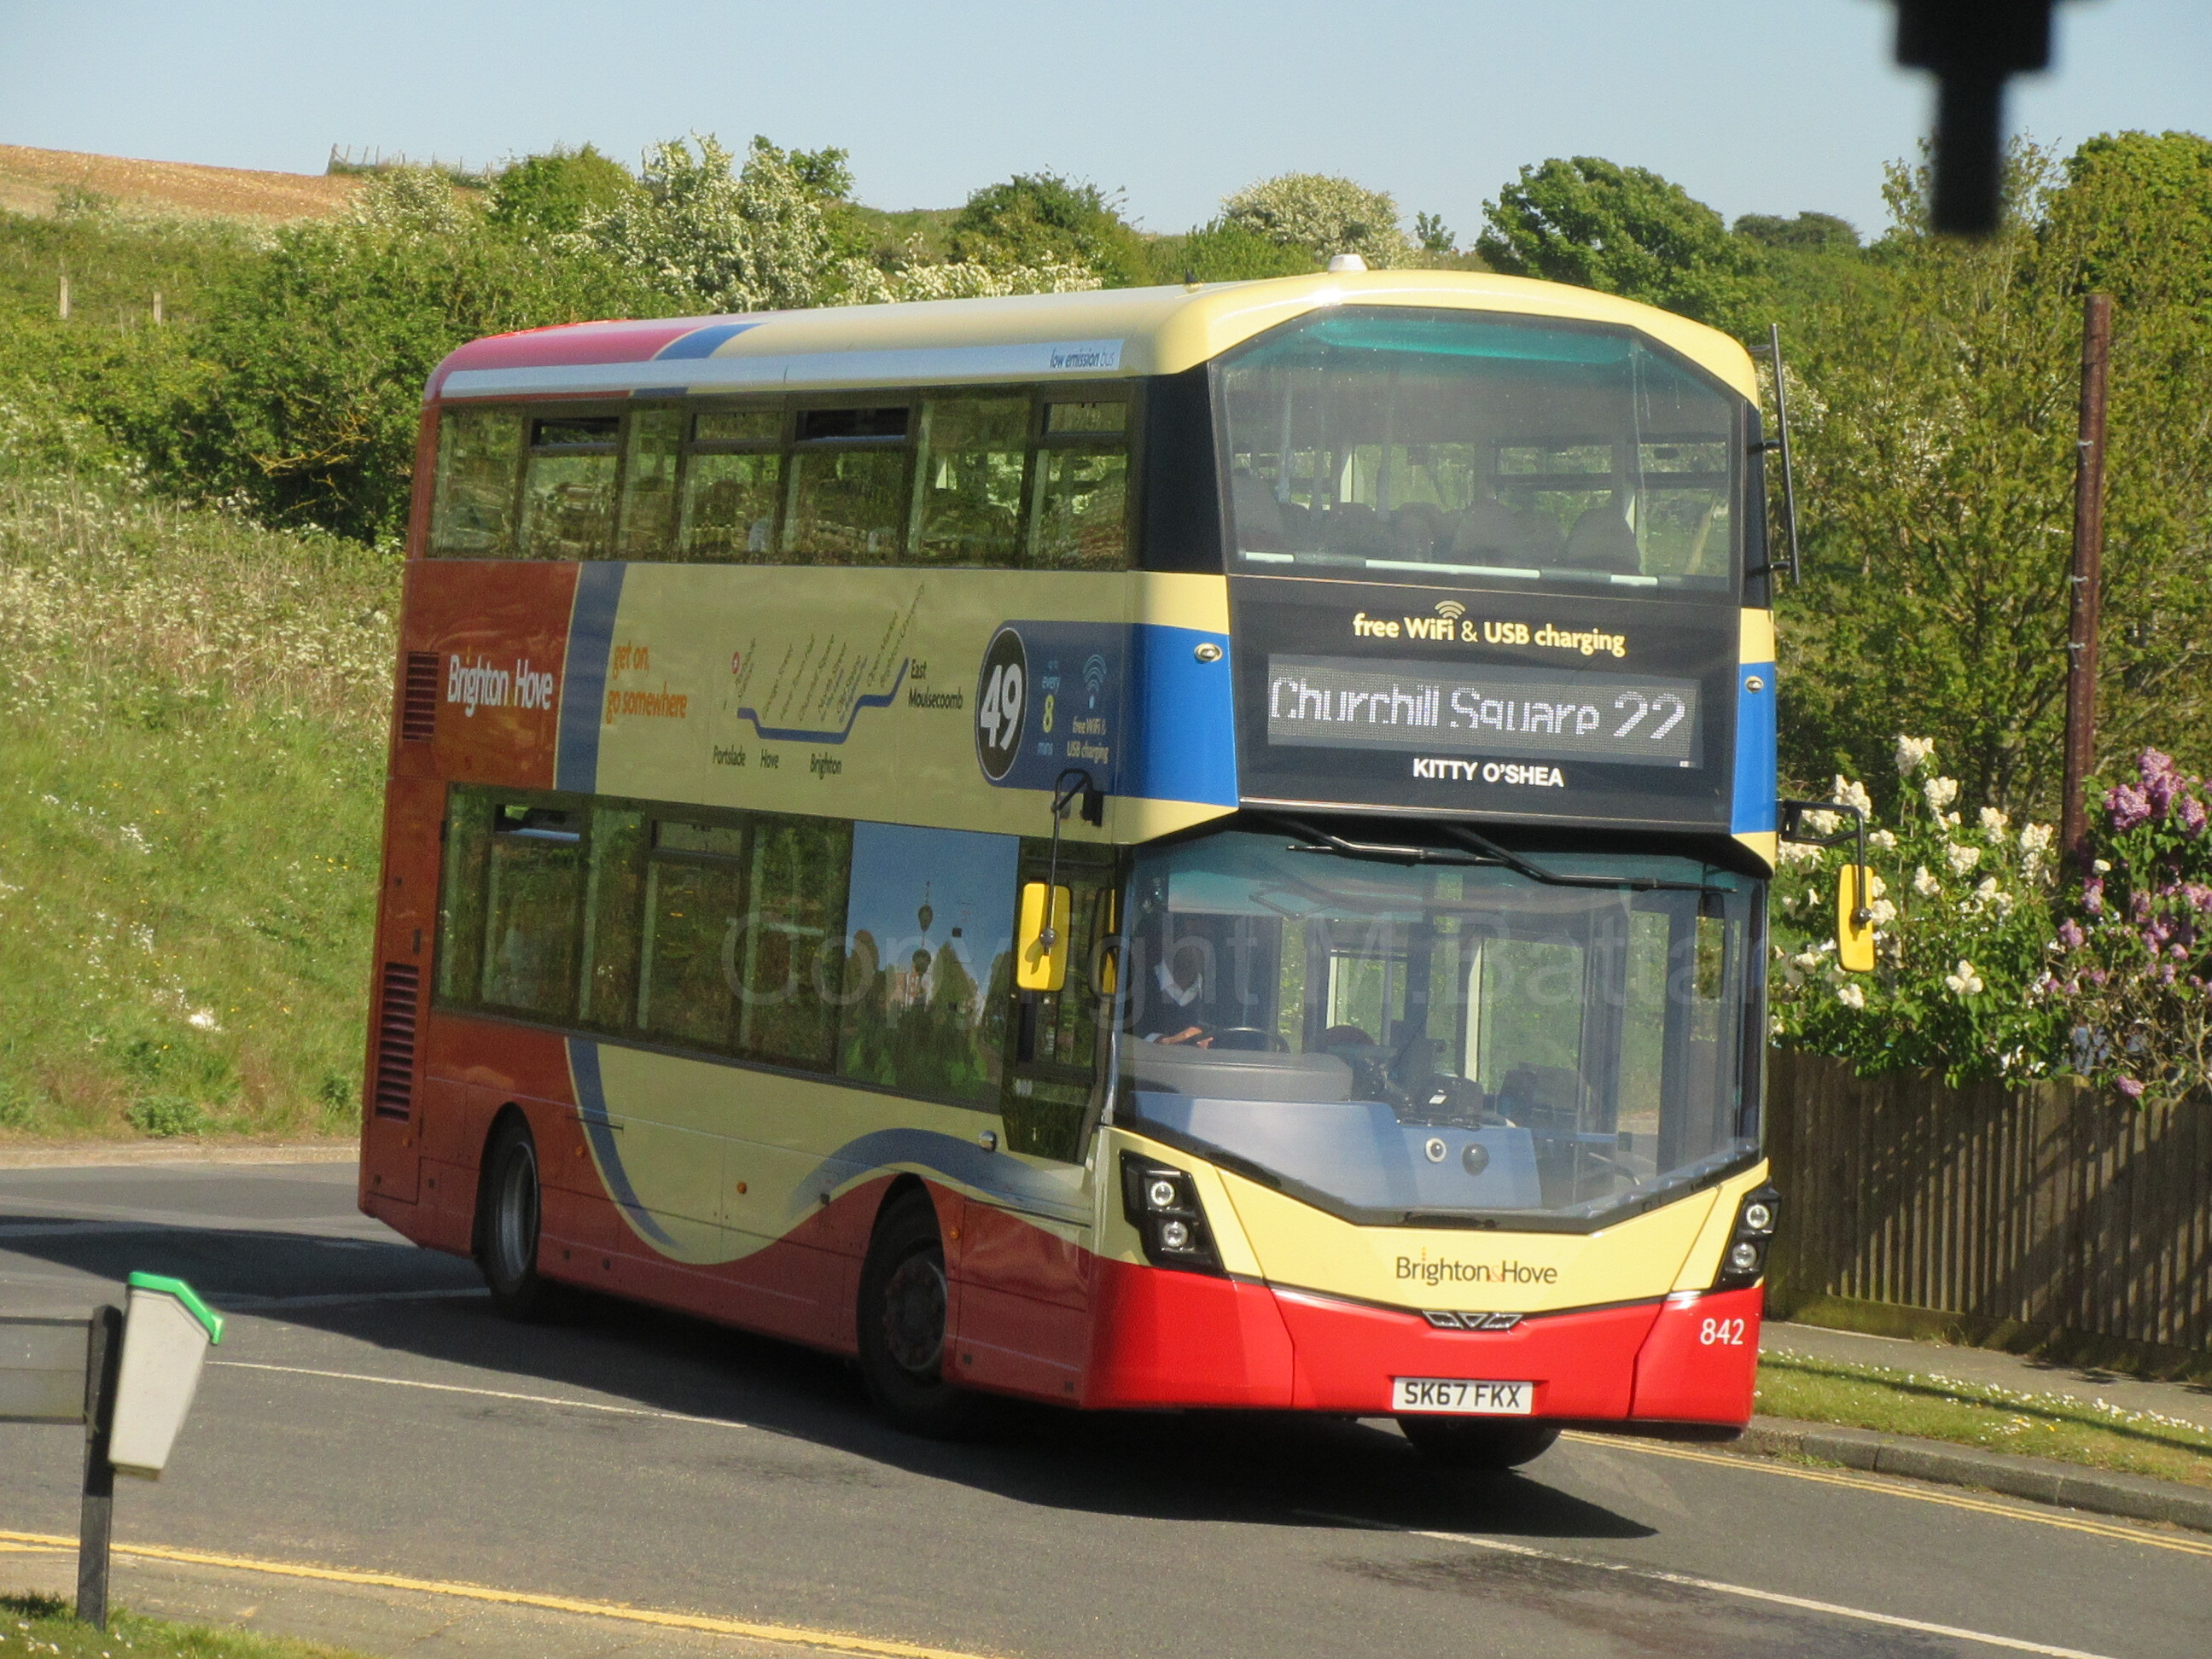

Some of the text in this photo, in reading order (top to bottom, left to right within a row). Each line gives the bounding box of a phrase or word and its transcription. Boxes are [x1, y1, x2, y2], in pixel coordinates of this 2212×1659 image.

[1050, 348, 1064, 368] low
[1065, 348, 1100, 368] emission
[1353, 614, 1627, 657] free WiFi & USB charging
[613, 641, 632, 679] get
[910, 660, 928, 679] East
[447, 655, 553, 717] Brighton Hove
[606, 681, 688, 724] go somewhere
[981, 663, 1022, 751] 49
[1042, 695, 1055, 733] 8
[1270, 675, 1686, 741] Churchill Square 22
[713, 746, 747, 766] Portslade
[760, 748, 780, 769] Hove
[810, 754, 842, 780] Brighton
[1412, 759, 1564, 788] KITTY O'SHEA
[1699, 1318, 1744, 1347] 842
[1404, 1382, 1522, 1410] SK67 FKX
